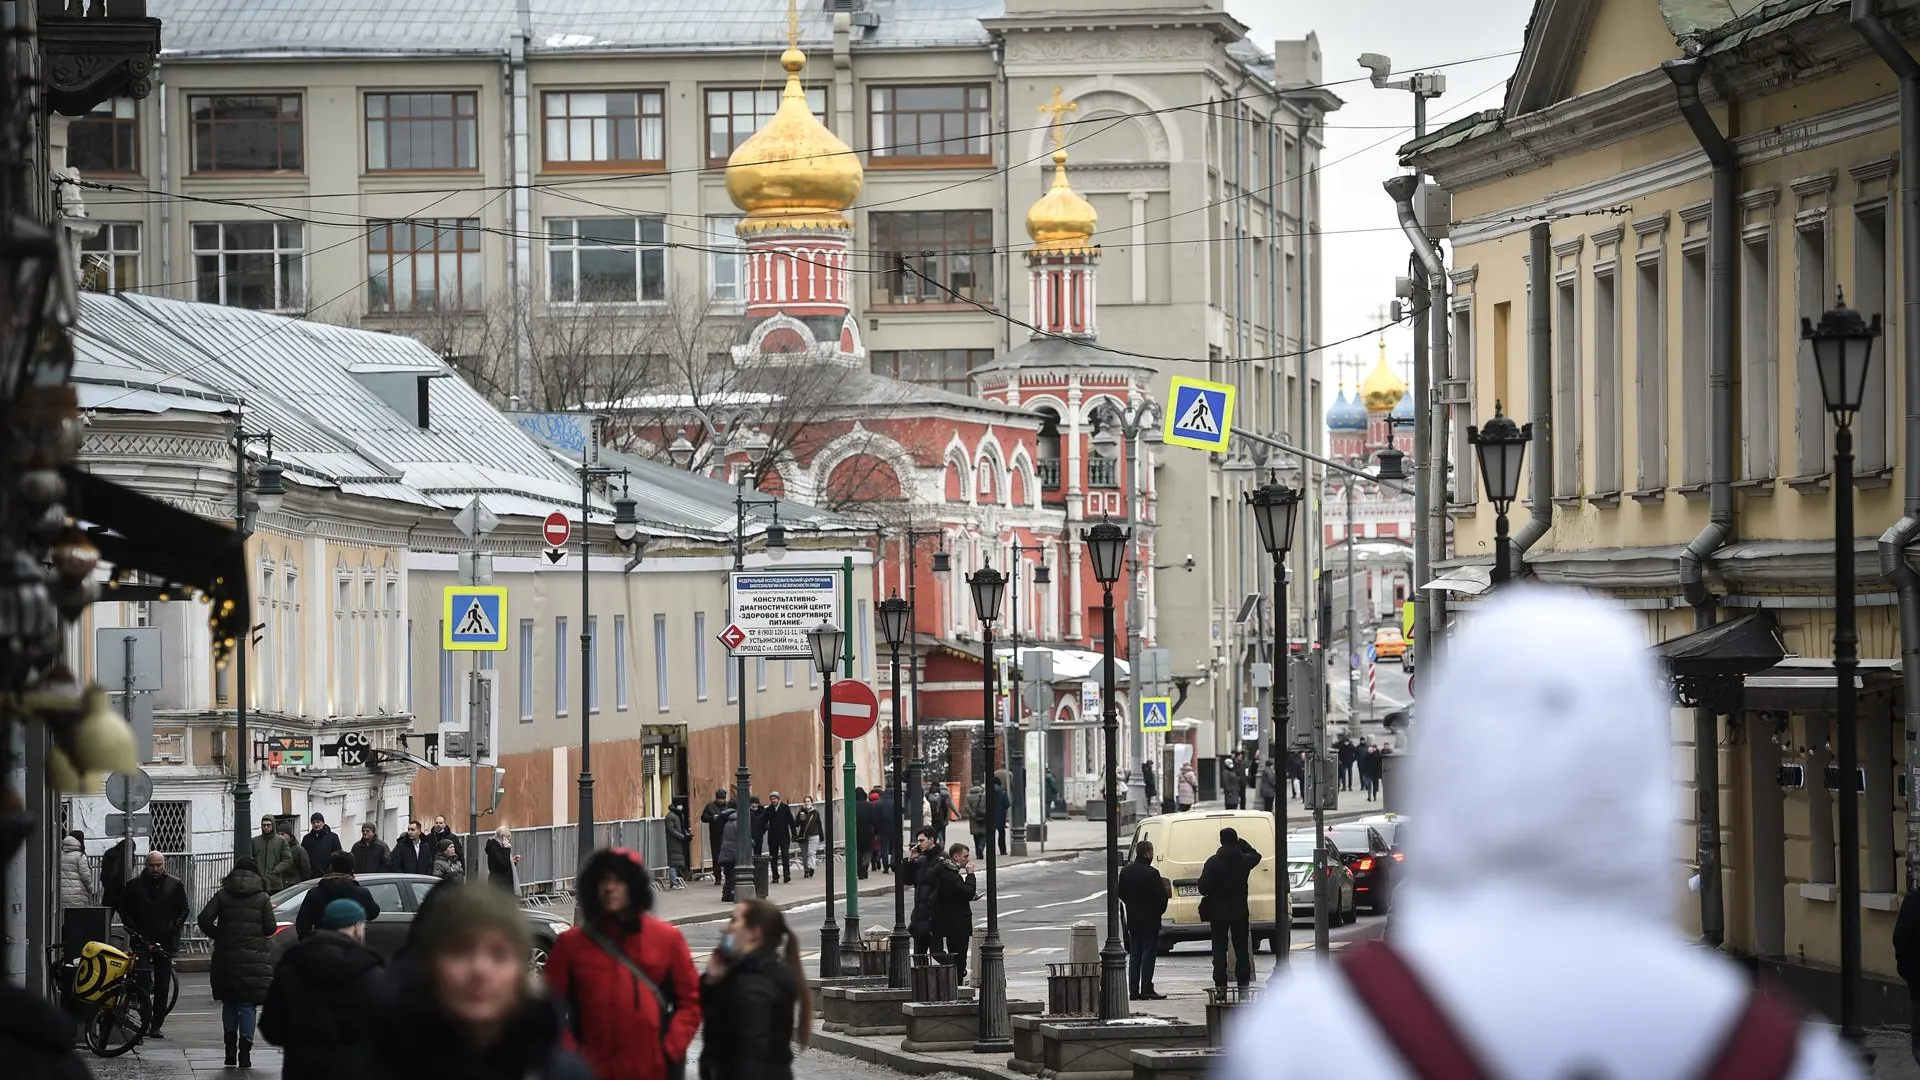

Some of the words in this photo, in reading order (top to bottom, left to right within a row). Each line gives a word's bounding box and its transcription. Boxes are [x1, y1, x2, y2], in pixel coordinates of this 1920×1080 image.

[740, 603, 808, 611] ДИАГНОСТИЧЕСКИЙ
[749, 636, 786, 644] УСТЬИНСКИЙ
[337, 746, 361, 763] fix
[427, 745, 438, 763] fi
